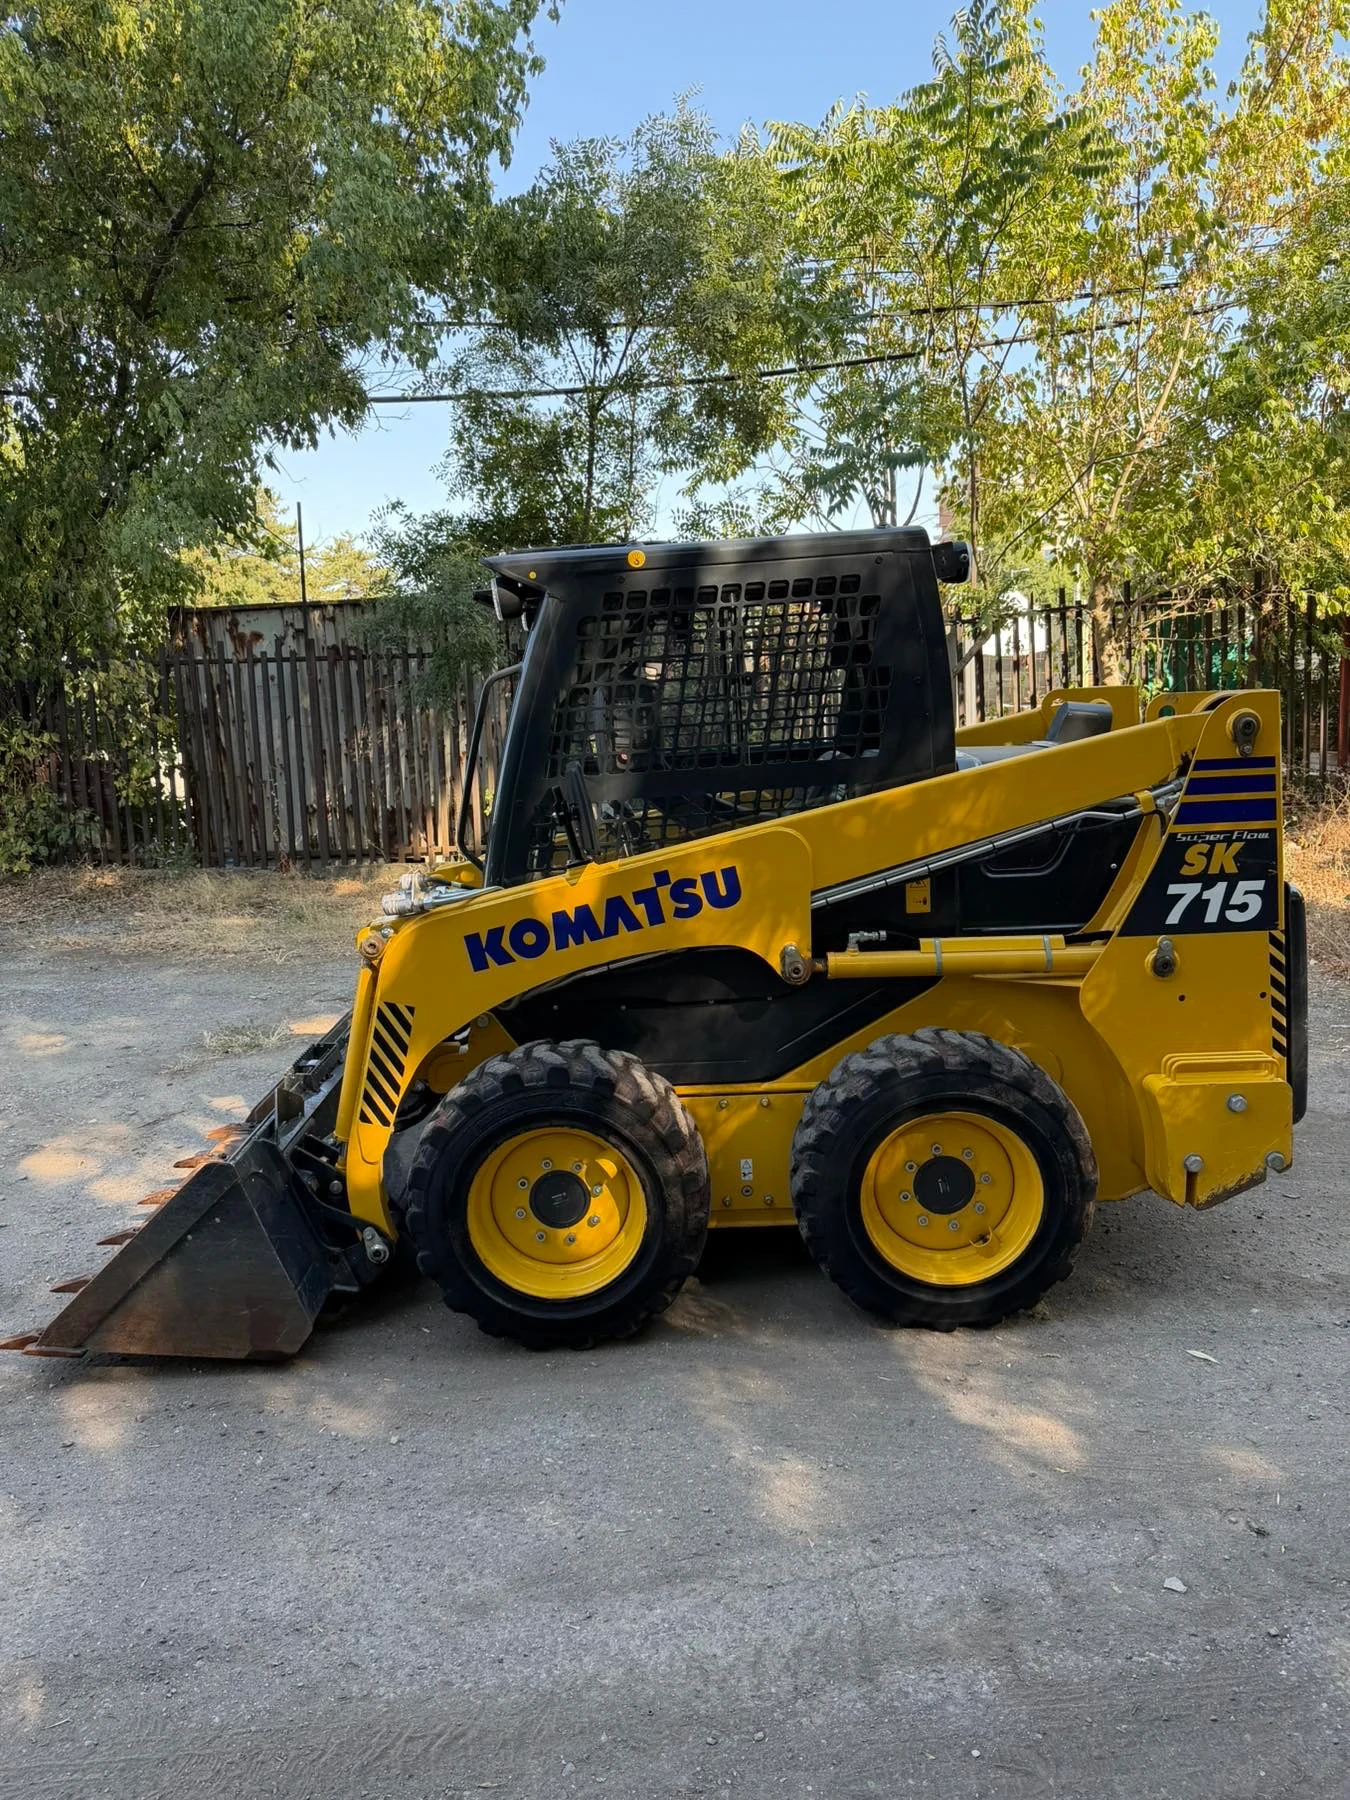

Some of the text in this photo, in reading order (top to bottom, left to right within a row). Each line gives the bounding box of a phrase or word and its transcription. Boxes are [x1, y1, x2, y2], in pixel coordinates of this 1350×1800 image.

[1176, 831, 1270, 842] Super Flow
[1179, 841, 1245, 875] SK
[464, 866, 742, 972] KOMATSU
[1165, 880, 1266, 925] 715
